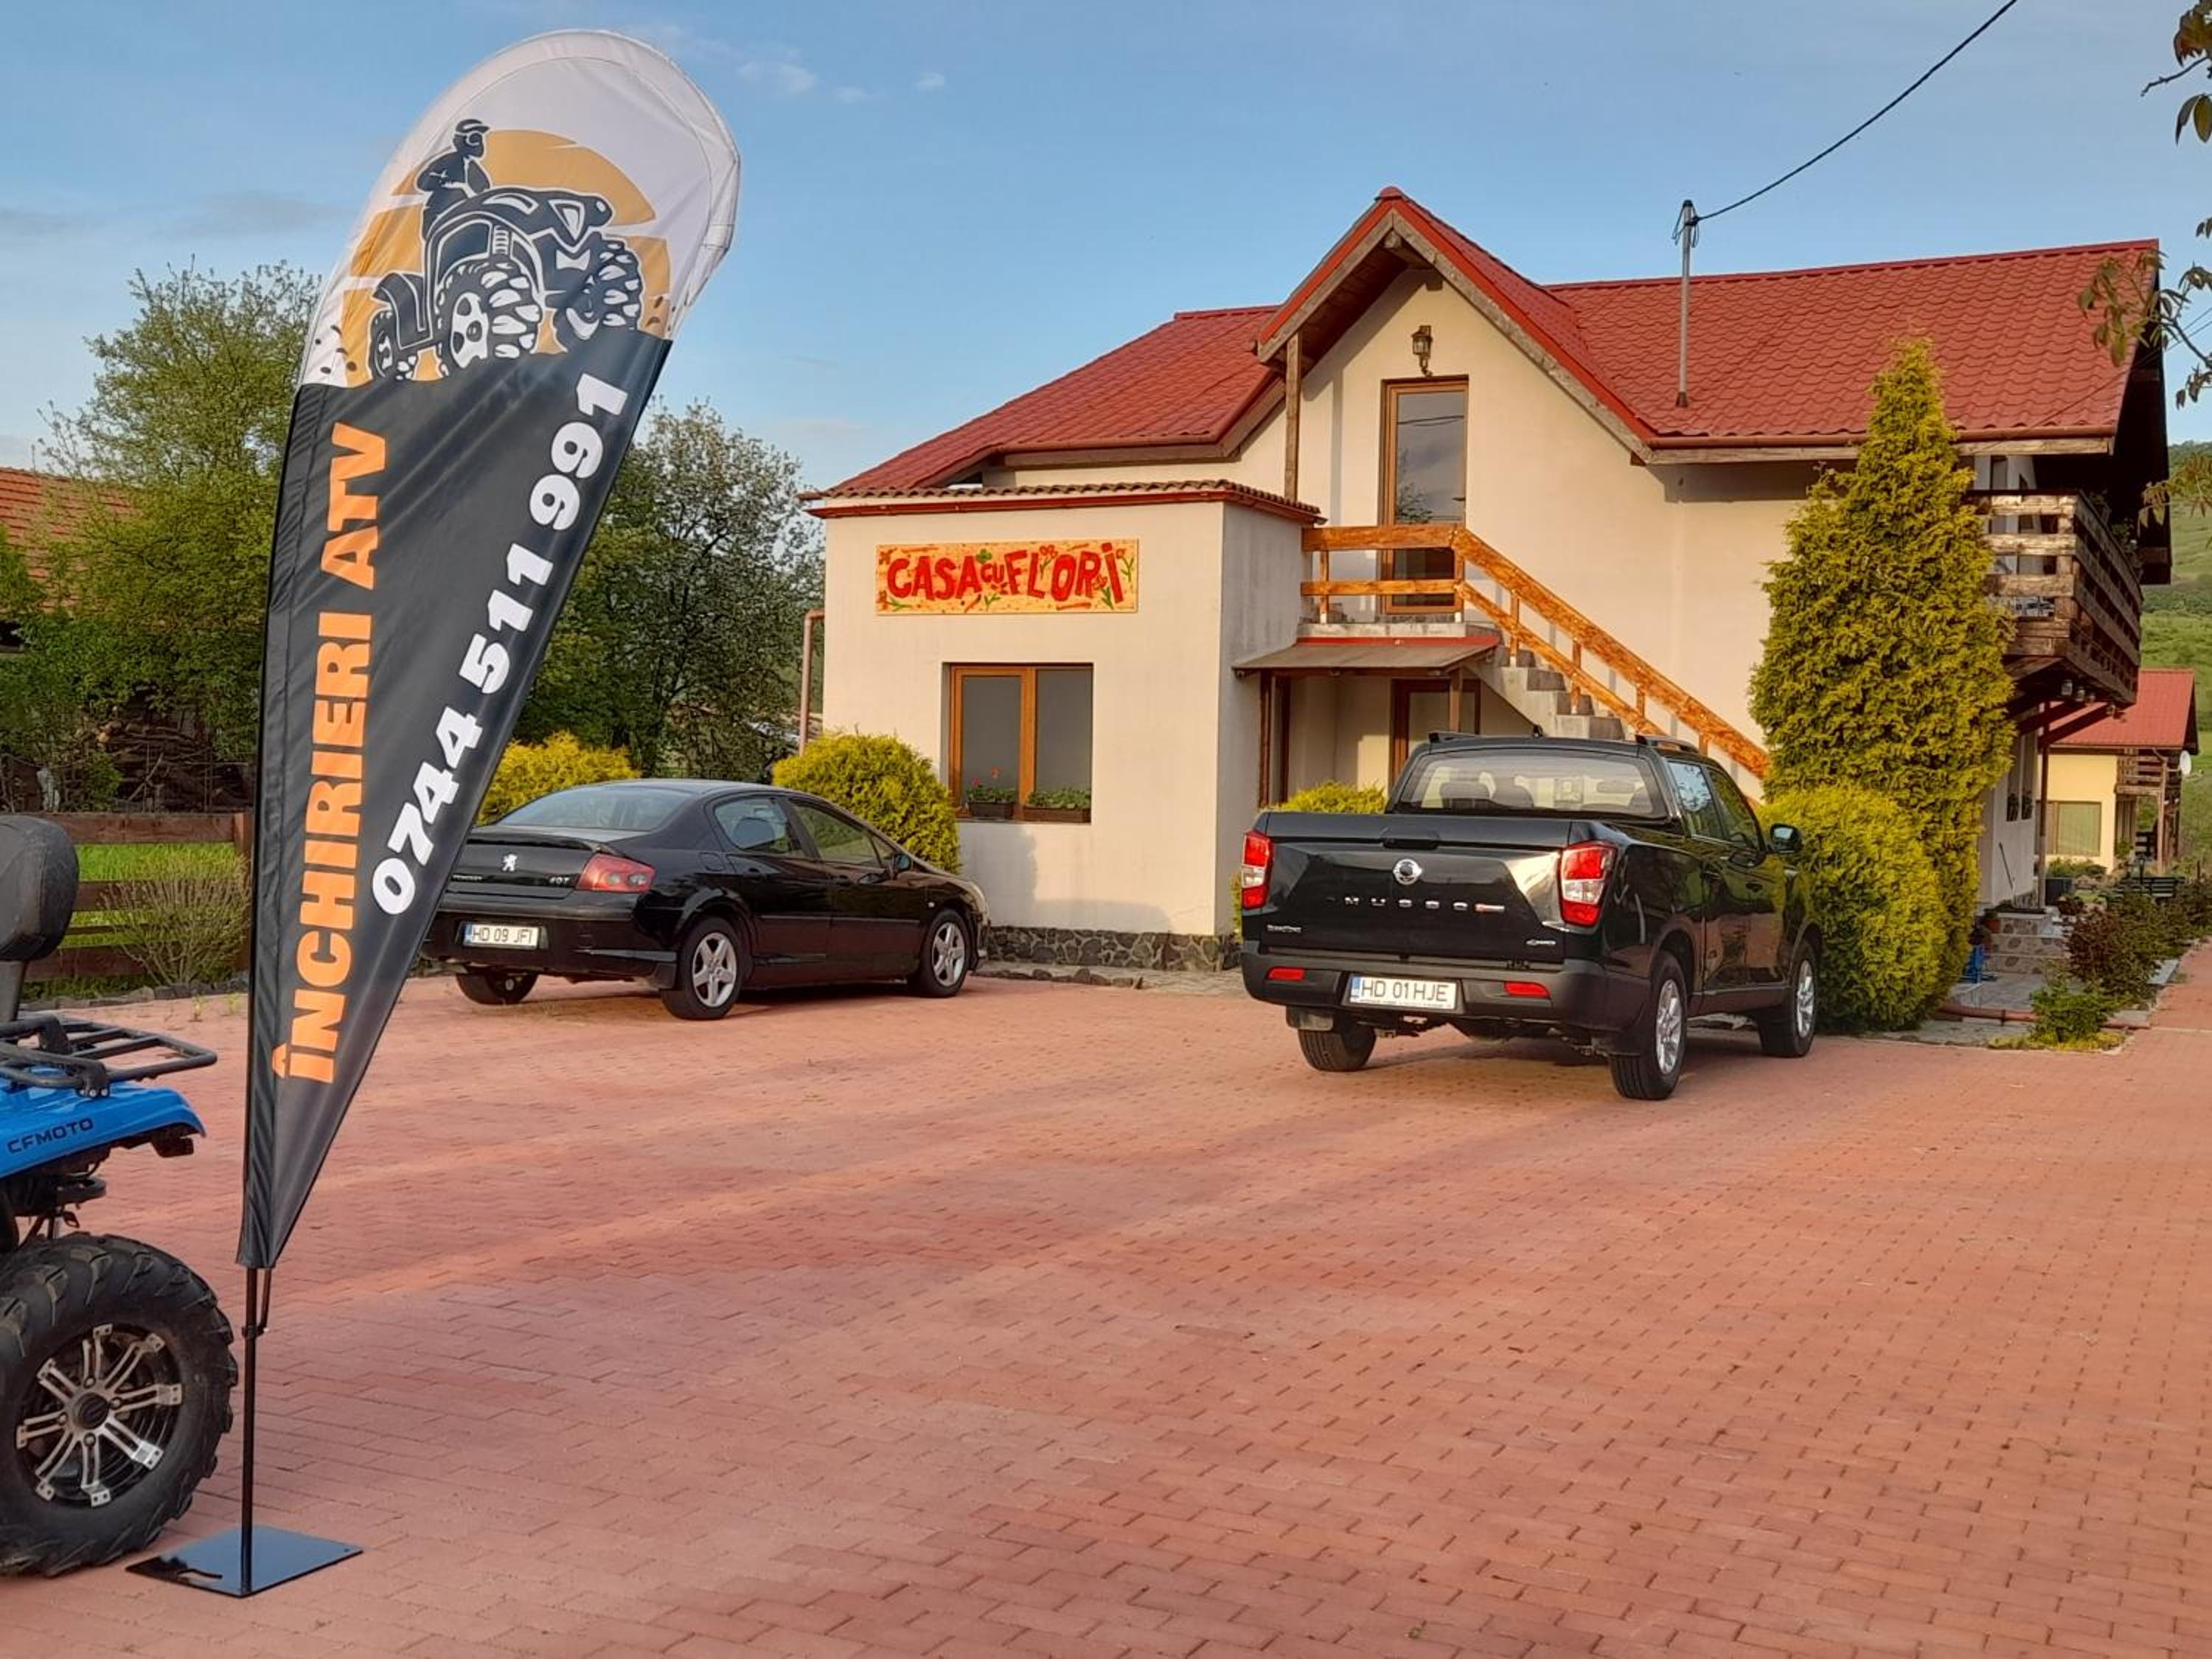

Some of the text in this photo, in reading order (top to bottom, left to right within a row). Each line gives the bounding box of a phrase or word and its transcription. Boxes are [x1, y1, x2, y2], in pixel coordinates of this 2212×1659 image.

[886, 554, 982, 601] CASA
[372, 372, 628, 915] 0744 511 991
[272, 422, 387, 1083] ÎNCHIRIERI ATV
[473, 927, 490, 942] HD
[493, 928, 509, 942] 09
[1361, 978, 1450, 1003] HD 01 HJE
[7, 1118, 94, 1153] CFMOTO
